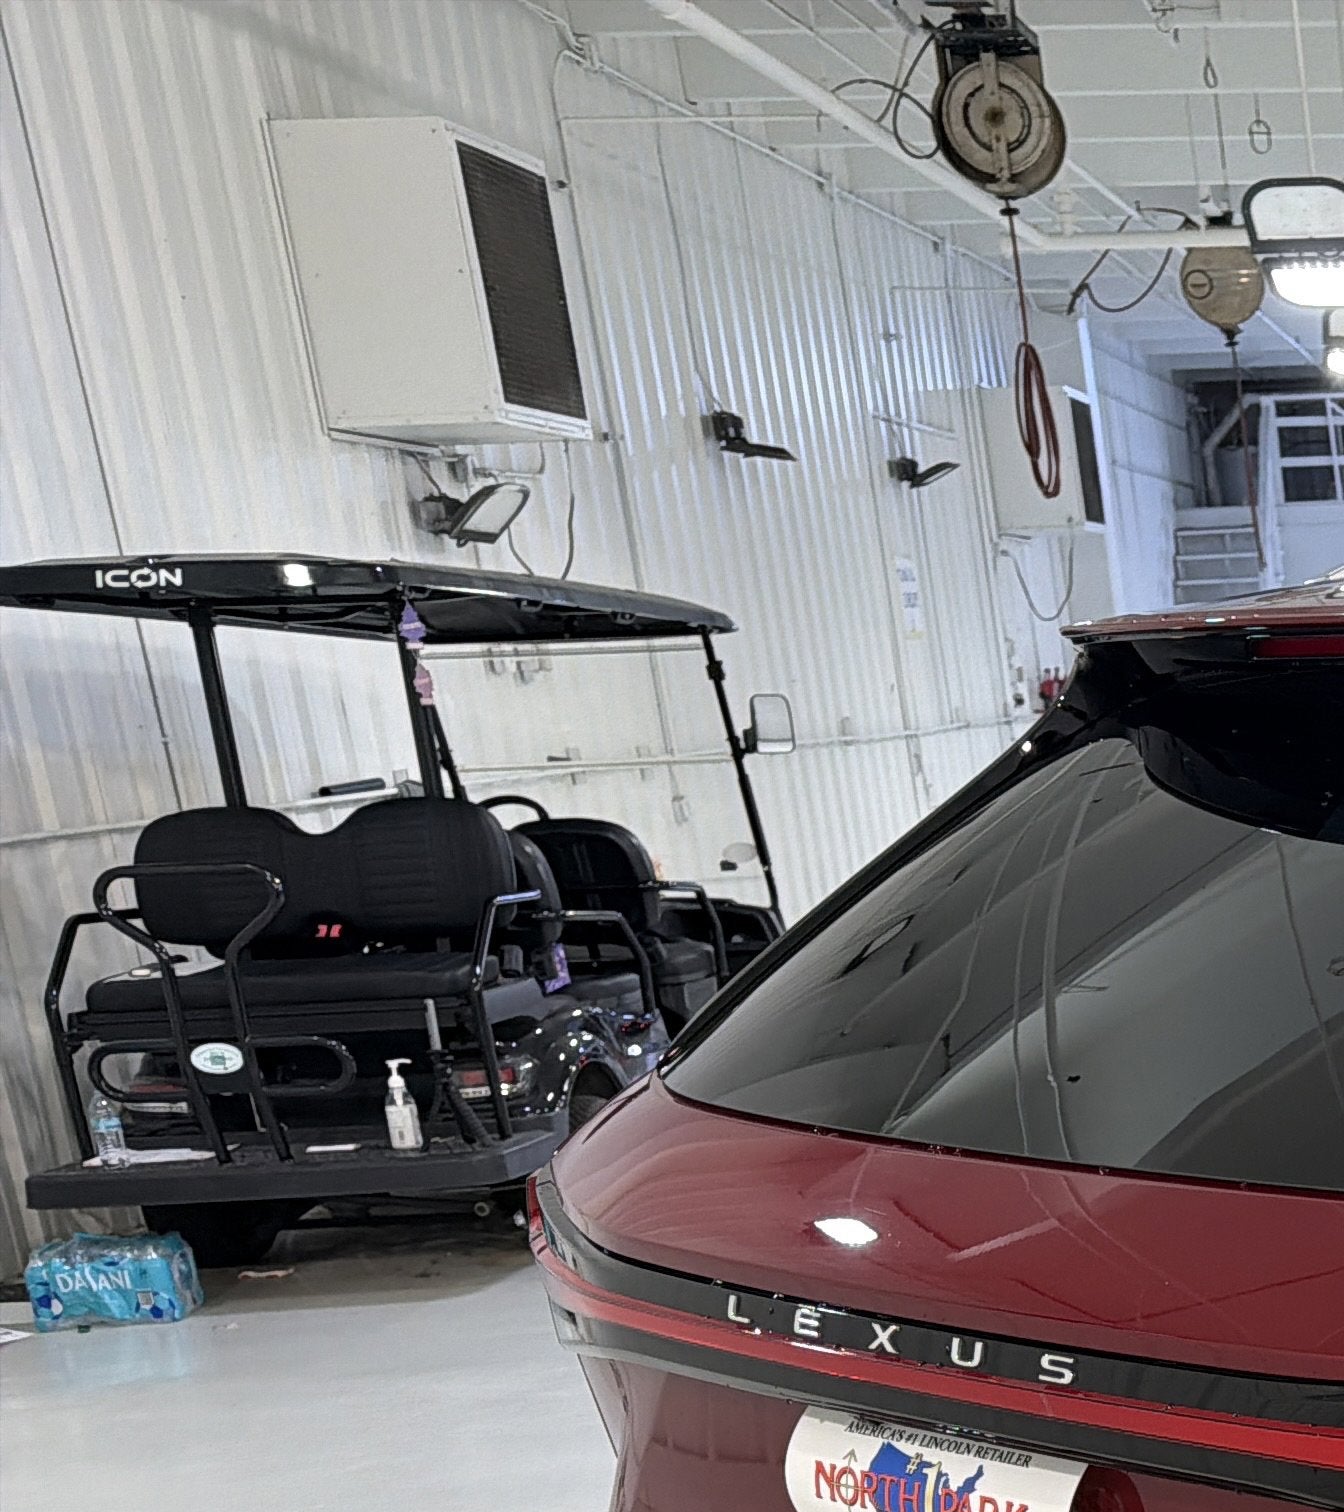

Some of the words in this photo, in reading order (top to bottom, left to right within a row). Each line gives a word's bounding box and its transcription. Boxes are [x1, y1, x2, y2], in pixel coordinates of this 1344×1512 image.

[95, 566, 183, 589] ICON
[727, 1294, 1075, 1386] LEXUS
[844, 1420, 907, 1443] AMERICA'S
[918, 1433, 976, 1457] LINCOLN
[973, 1445, 1033, 1469] RETAILER
